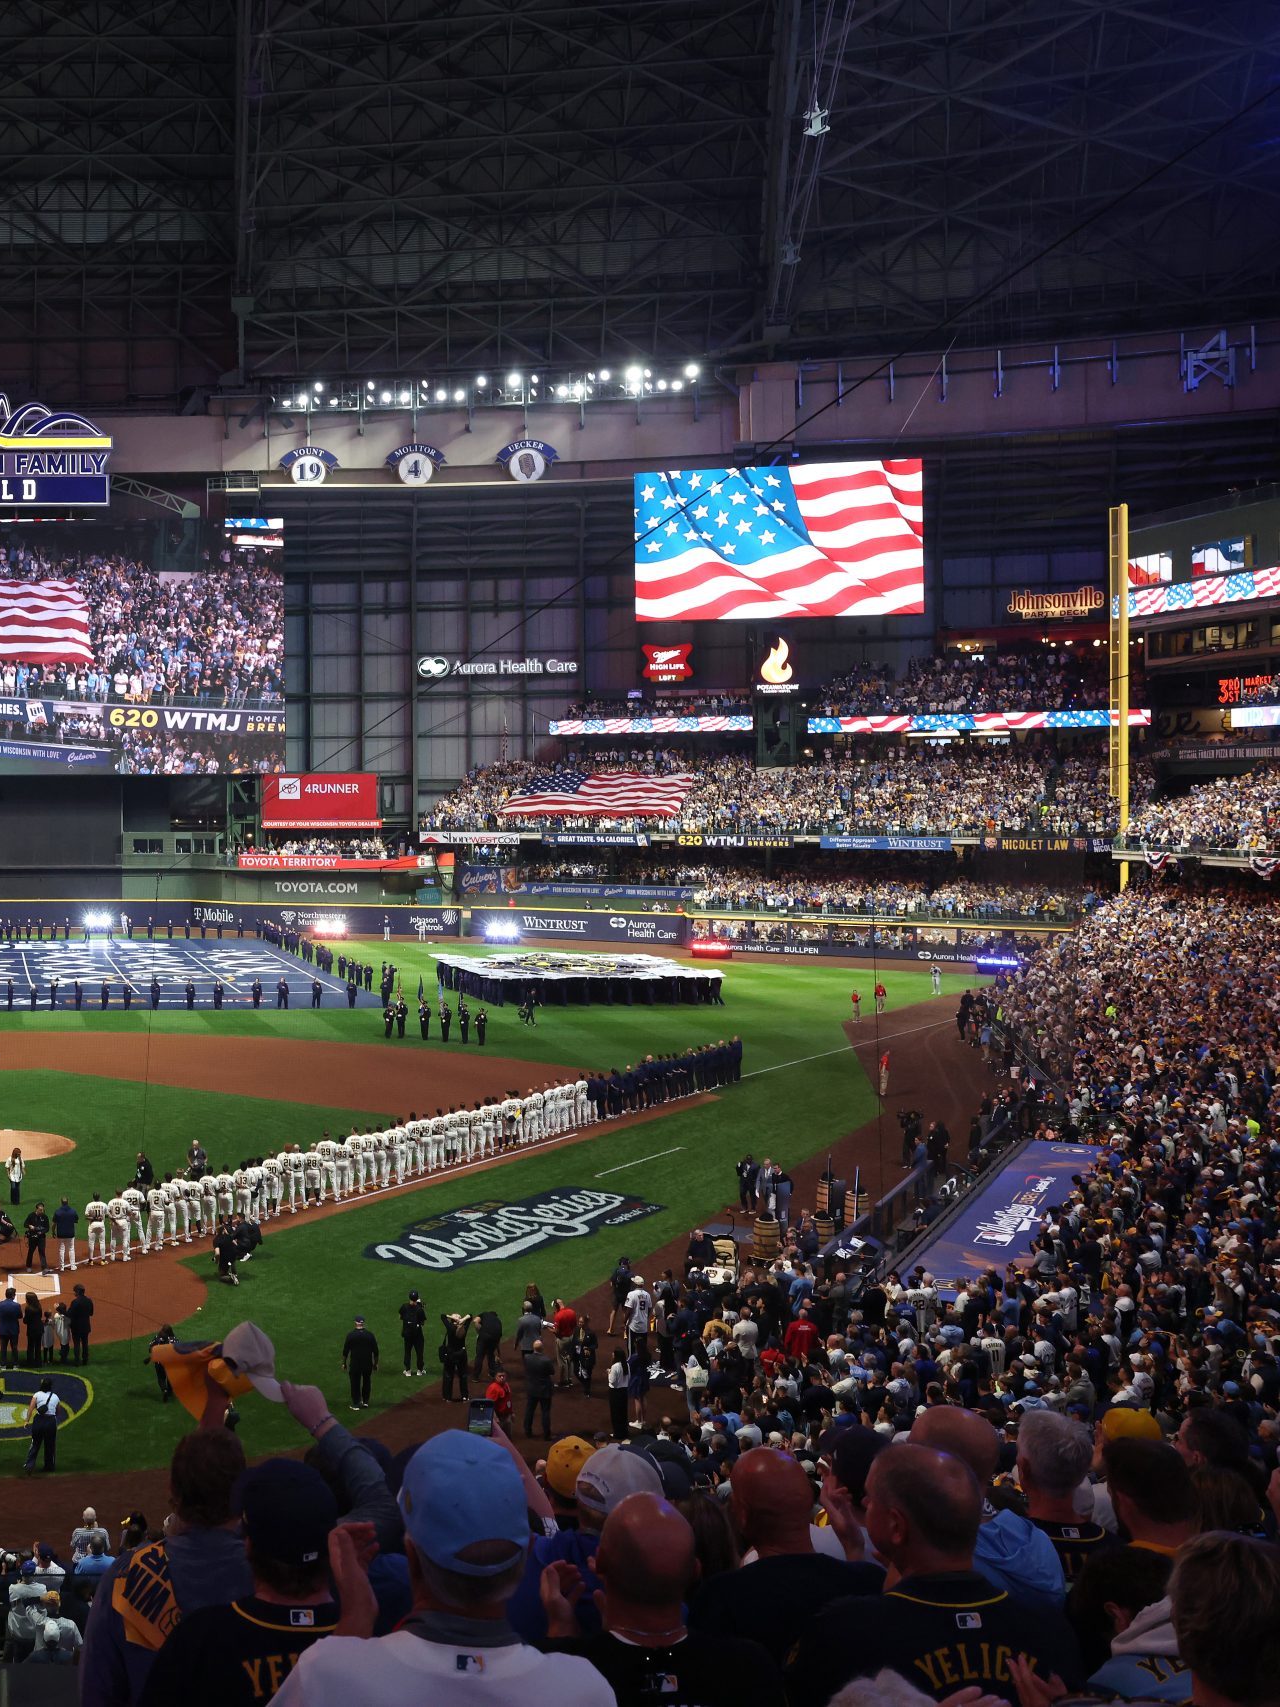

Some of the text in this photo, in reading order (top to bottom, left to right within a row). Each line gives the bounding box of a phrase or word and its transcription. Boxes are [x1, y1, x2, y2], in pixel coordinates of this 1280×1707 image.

[394, 444, 437, 457] MOLITOR
[508, 440, 544, 452] UECKER
[292, 448, 324, 457] YOUNT
[15, 454, 108, 476] FAMILY
[407, 459, 422, 479] 4
[296, 462, 322, 482] 19
[1008, 586, 1104, 613] Johnsonville
[1024, 610, 1056, 618] PARTY
[451, 658, 578, 676] Aurora Health Care
[1245, 675, 1272, 686] MARKET
[109, 708, 241, 731] 620 WTMJ
[248, 715, 277, 723] HOME
[3, 746, 32, 757] WISCONSIN
[32, 749, 46, 758] WITH
[304, 783, 360, 794] 4RUNNER
[557, 835, 576, 843] GREAT
[577, 835, 596, 843] TASTE.
[678, 835, 744, 846] 620 WTMJ
[888, 838, 944, 848] WINTRUST
[1001, 840, 1069, 850] NICOLET LAW
[241, 857, 337, 867] TOYOTA TERRITORY
[275, 881, 358, 893] TOYOTA.COM
[297, 911, 346, 920] Northwestern
[523, 916, 586, 930] WINTRUST
[628, 920, 655, 929] Aurora
[627, 929, 677, 939] Health Care
[744, 944, 764, 952] Health
[765, 945, 780, 953] Care
[784, 946, 819, 954] BULLPEN
[932, 953, 978, 962] Aurora Health
[491, 1188, 625, 1238] Series
[375, 1214, 520, 1268] World
